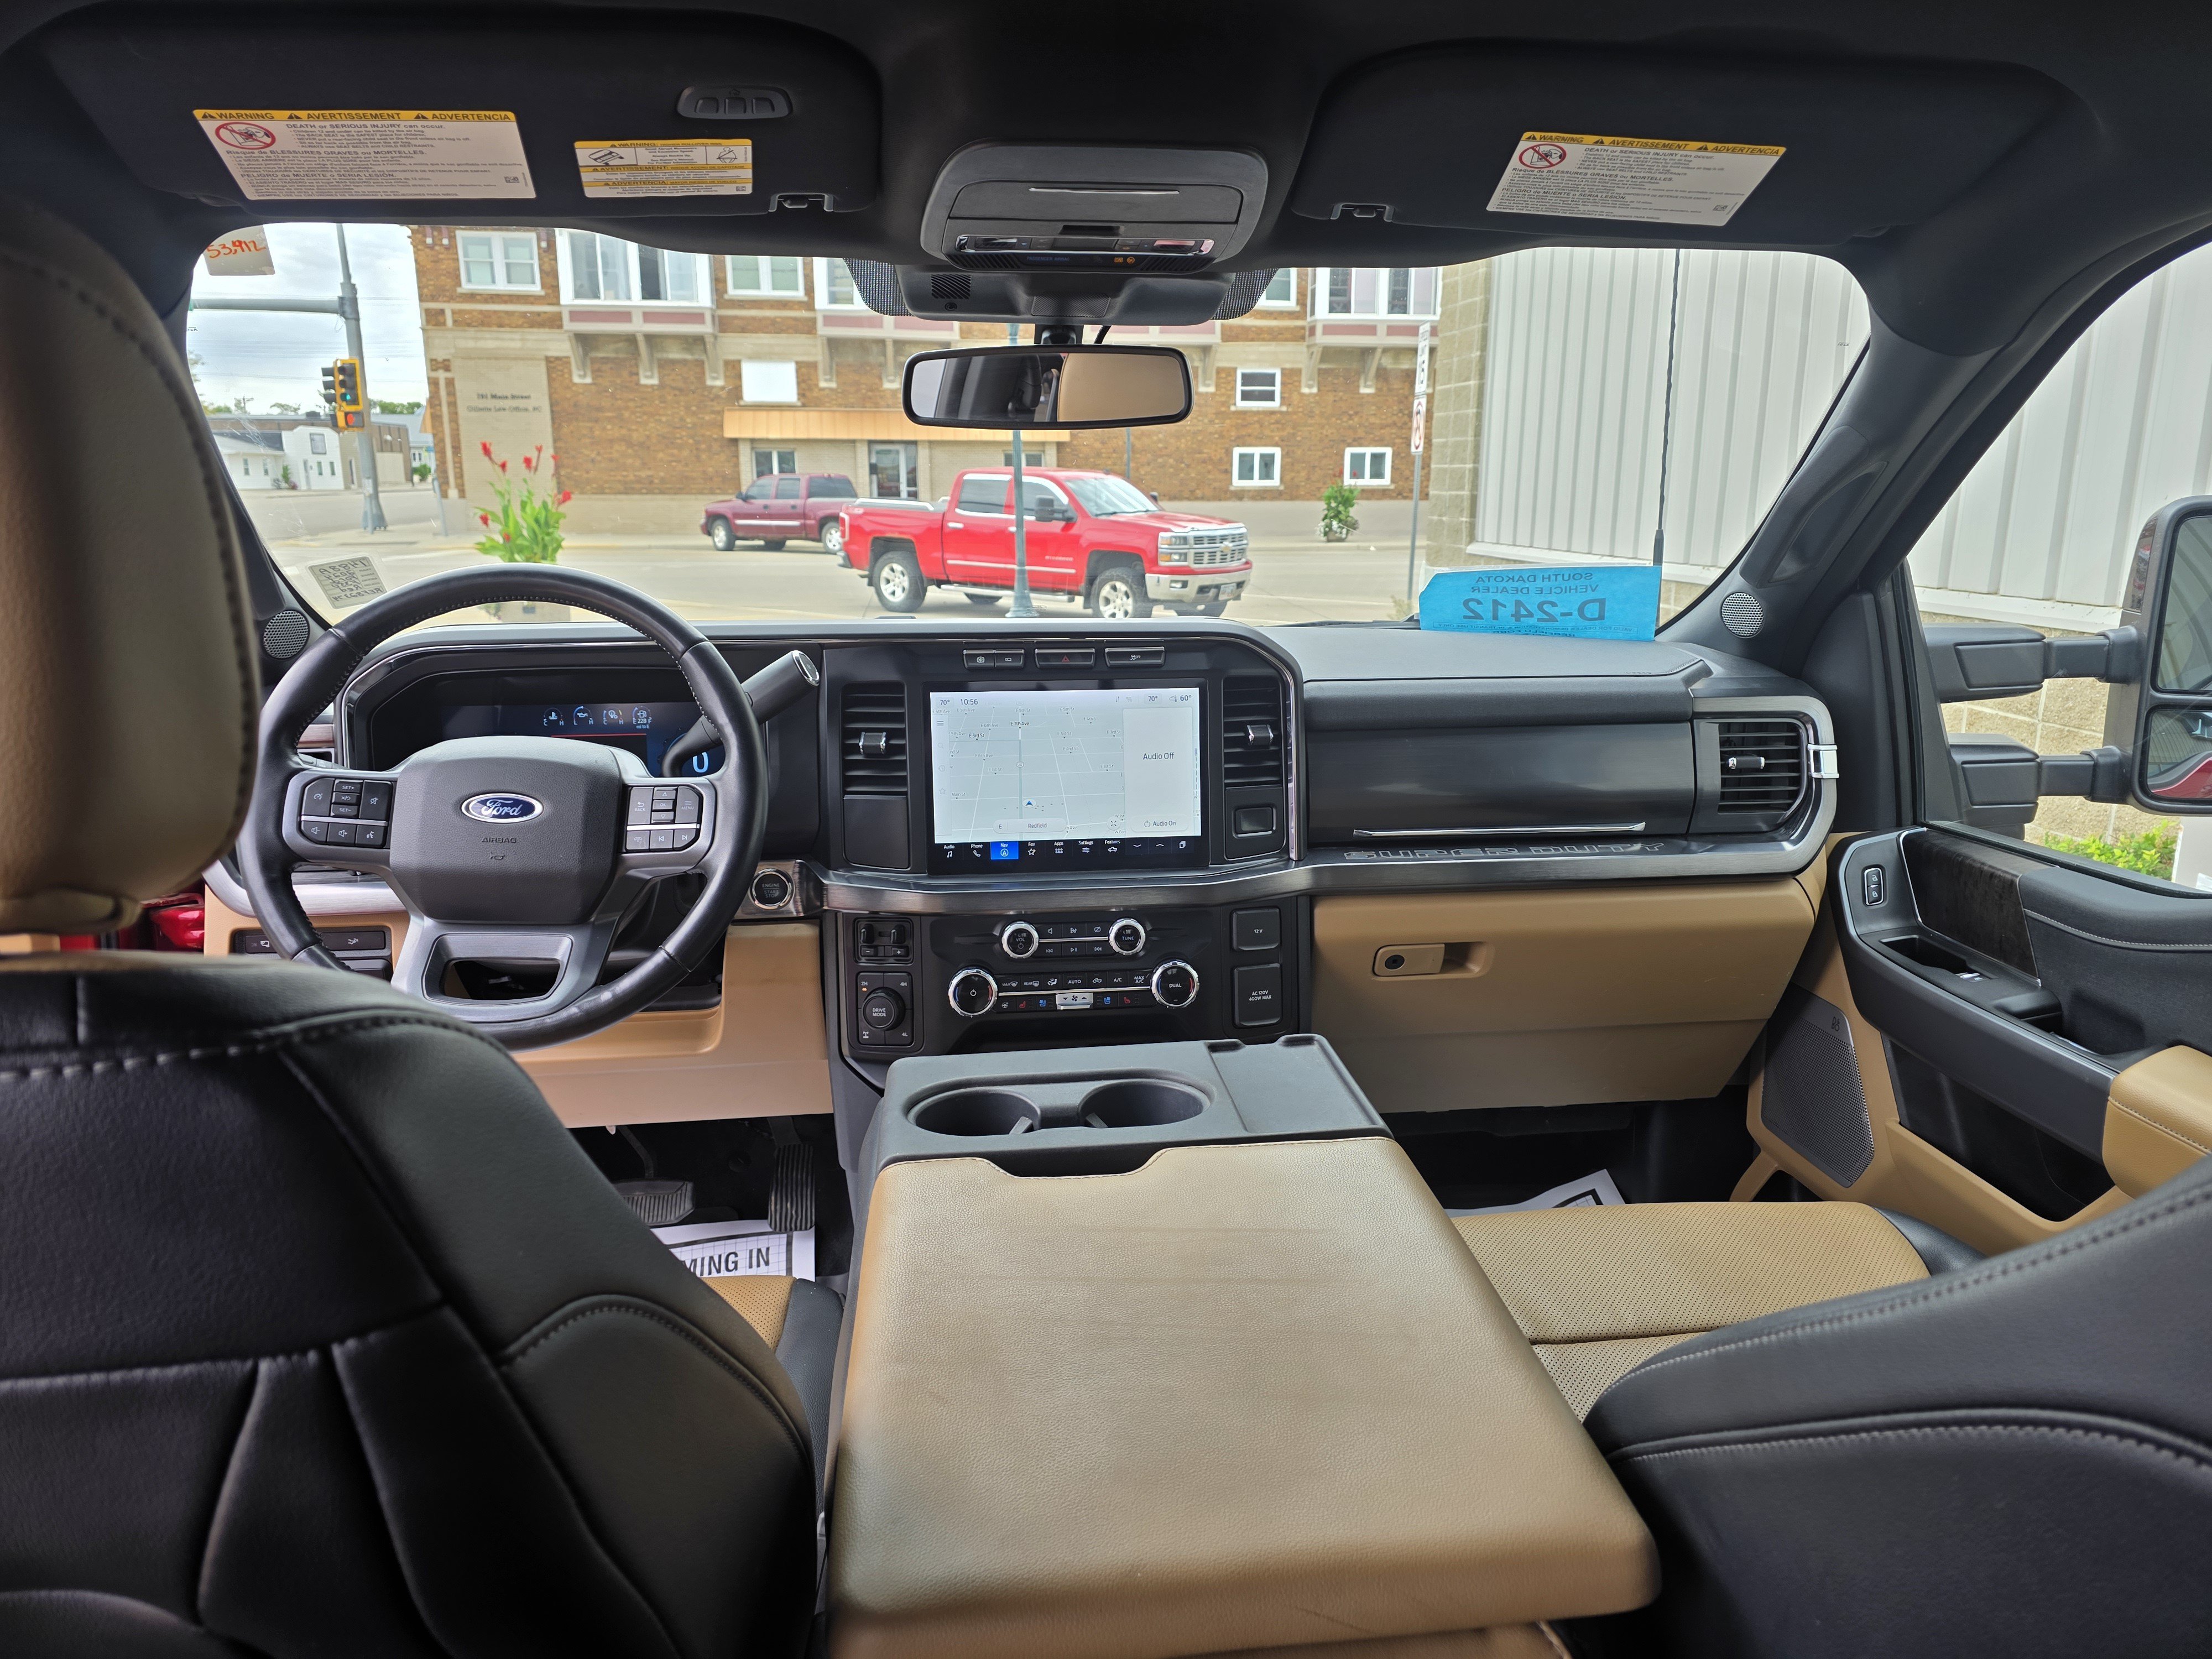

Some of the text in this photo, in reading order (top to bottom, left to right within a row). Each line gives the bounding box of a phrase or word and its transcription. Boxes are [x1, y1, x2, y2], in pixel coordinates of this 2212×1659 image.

[1539, 134, 1780, 155] WARNING AVERTISSEMENT ADVERTENCIA
[481, 799, 523, 816] Ford
[1344, 843, 1665, 860] SUPER DUTY
[749, 1246, 770, 1269] IN
